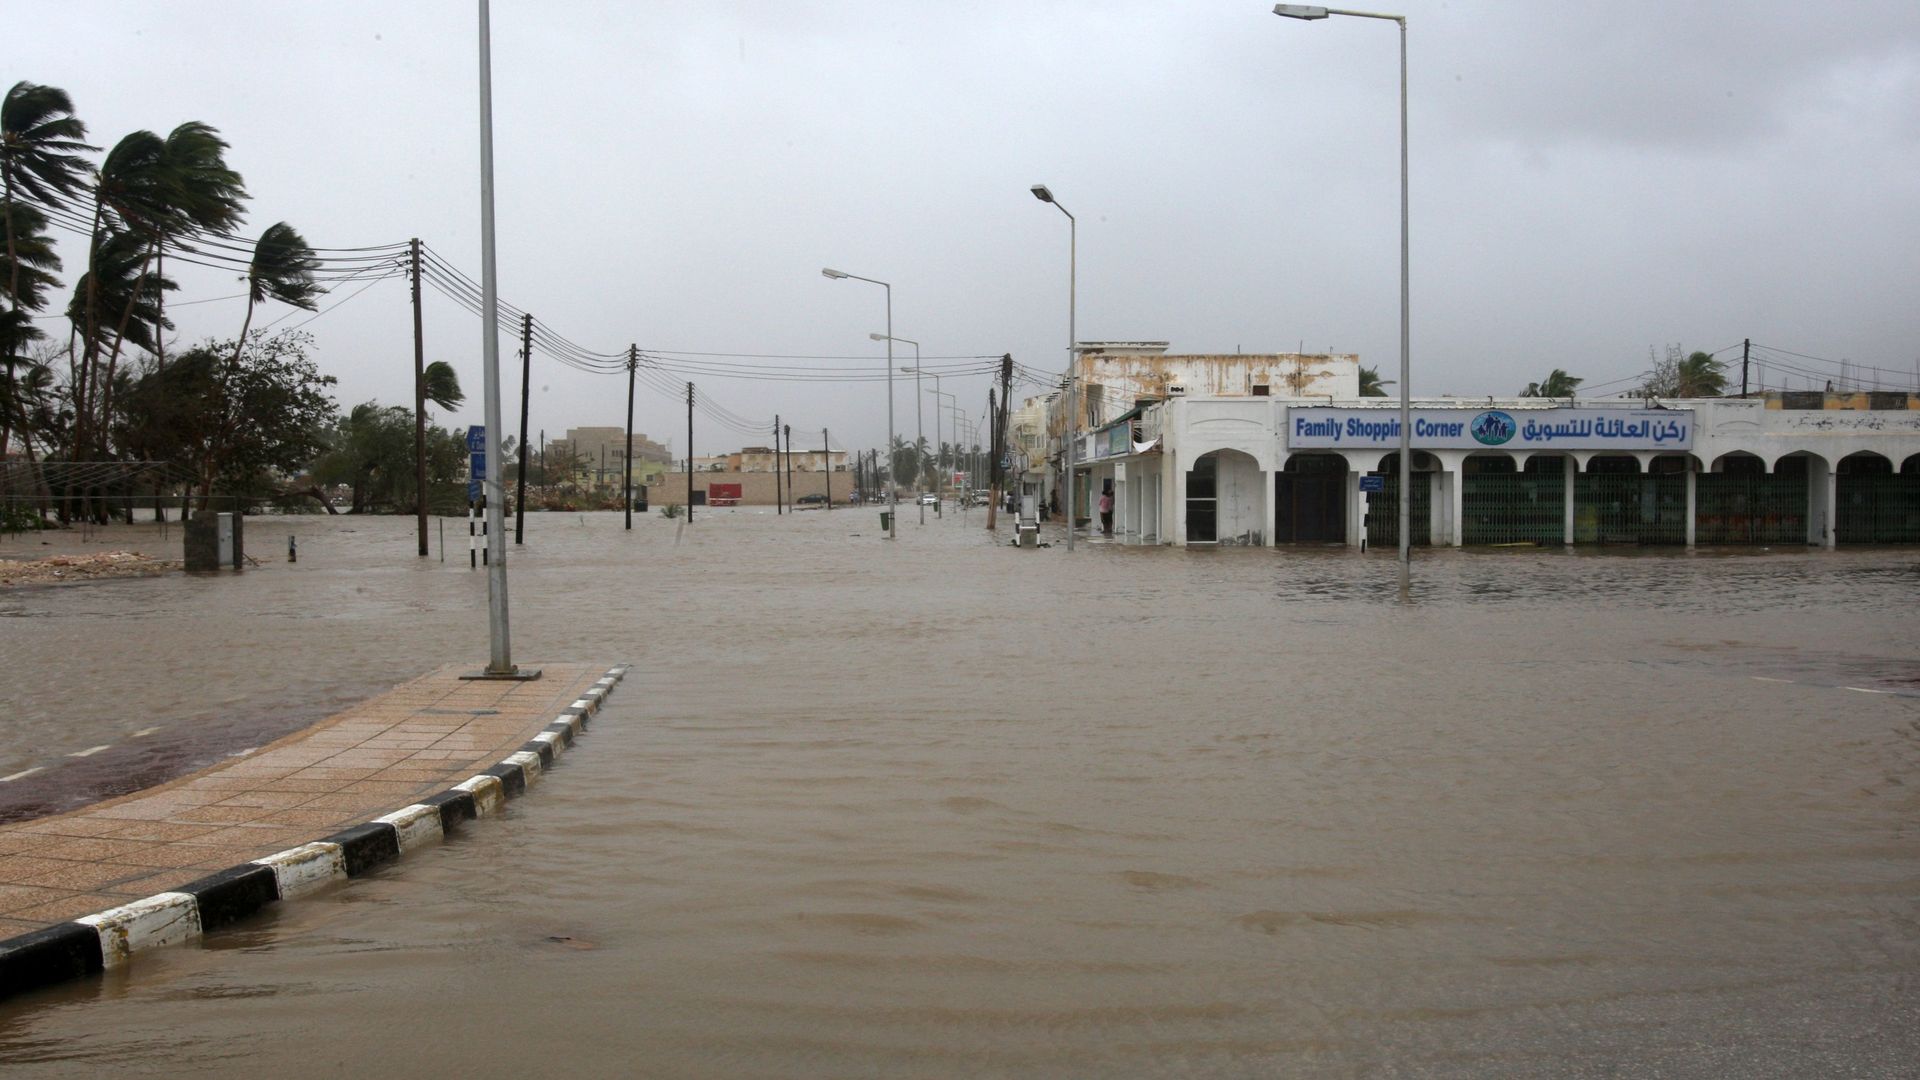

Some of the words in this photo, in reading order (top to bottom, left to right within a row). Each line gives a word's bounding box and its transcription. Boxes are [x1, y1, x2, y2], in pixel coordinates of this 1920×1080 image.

[1296, 418, 1342, 441] Family
[1346, 418, 1411, 441] Shoppin
[1416, 418, 1464, 437] Corner
[1522, 419, 1592, 441] للتسويق
[1594, 417, 1650, 438] العائلة
[1652, 420, 1686, 442] ركن
